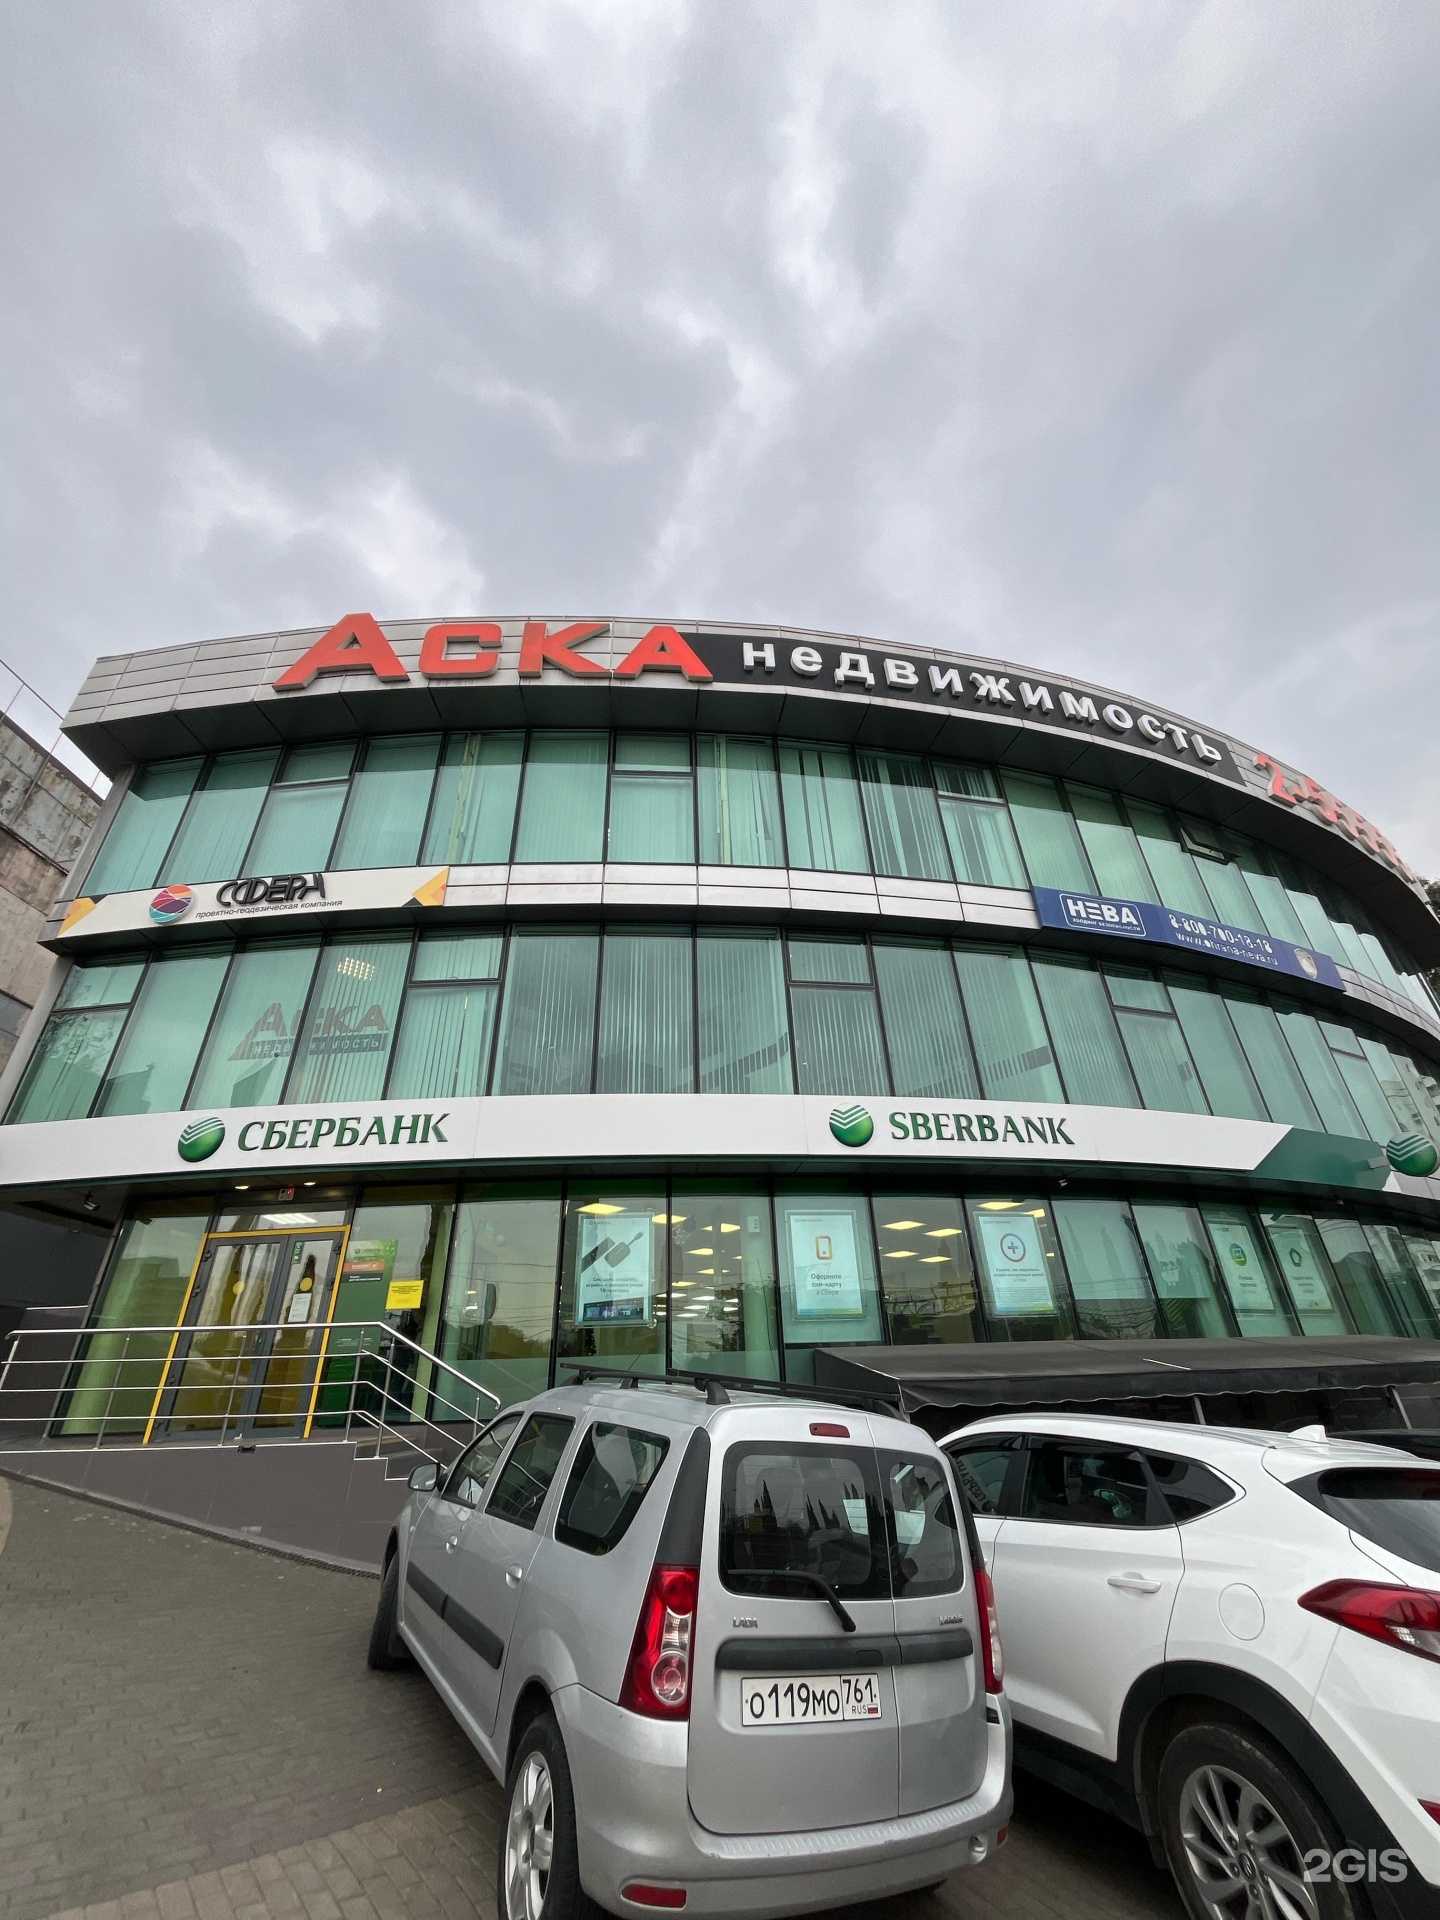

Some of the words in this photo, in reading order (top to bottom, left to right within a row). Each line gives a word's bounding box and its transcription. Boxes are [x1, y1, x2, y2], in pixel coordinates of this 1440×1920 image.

[272, 612, 714, 691] АСКА
[741, 641, 1223, 766] недвижимость
[237, 1112, 451, 1152] СБЕРБАНК
[888, 1111, 1075, 1145] SBERBANK
[842, 1677, 874, 1705] 761
[851, 1704, 867, 1715] RUS
